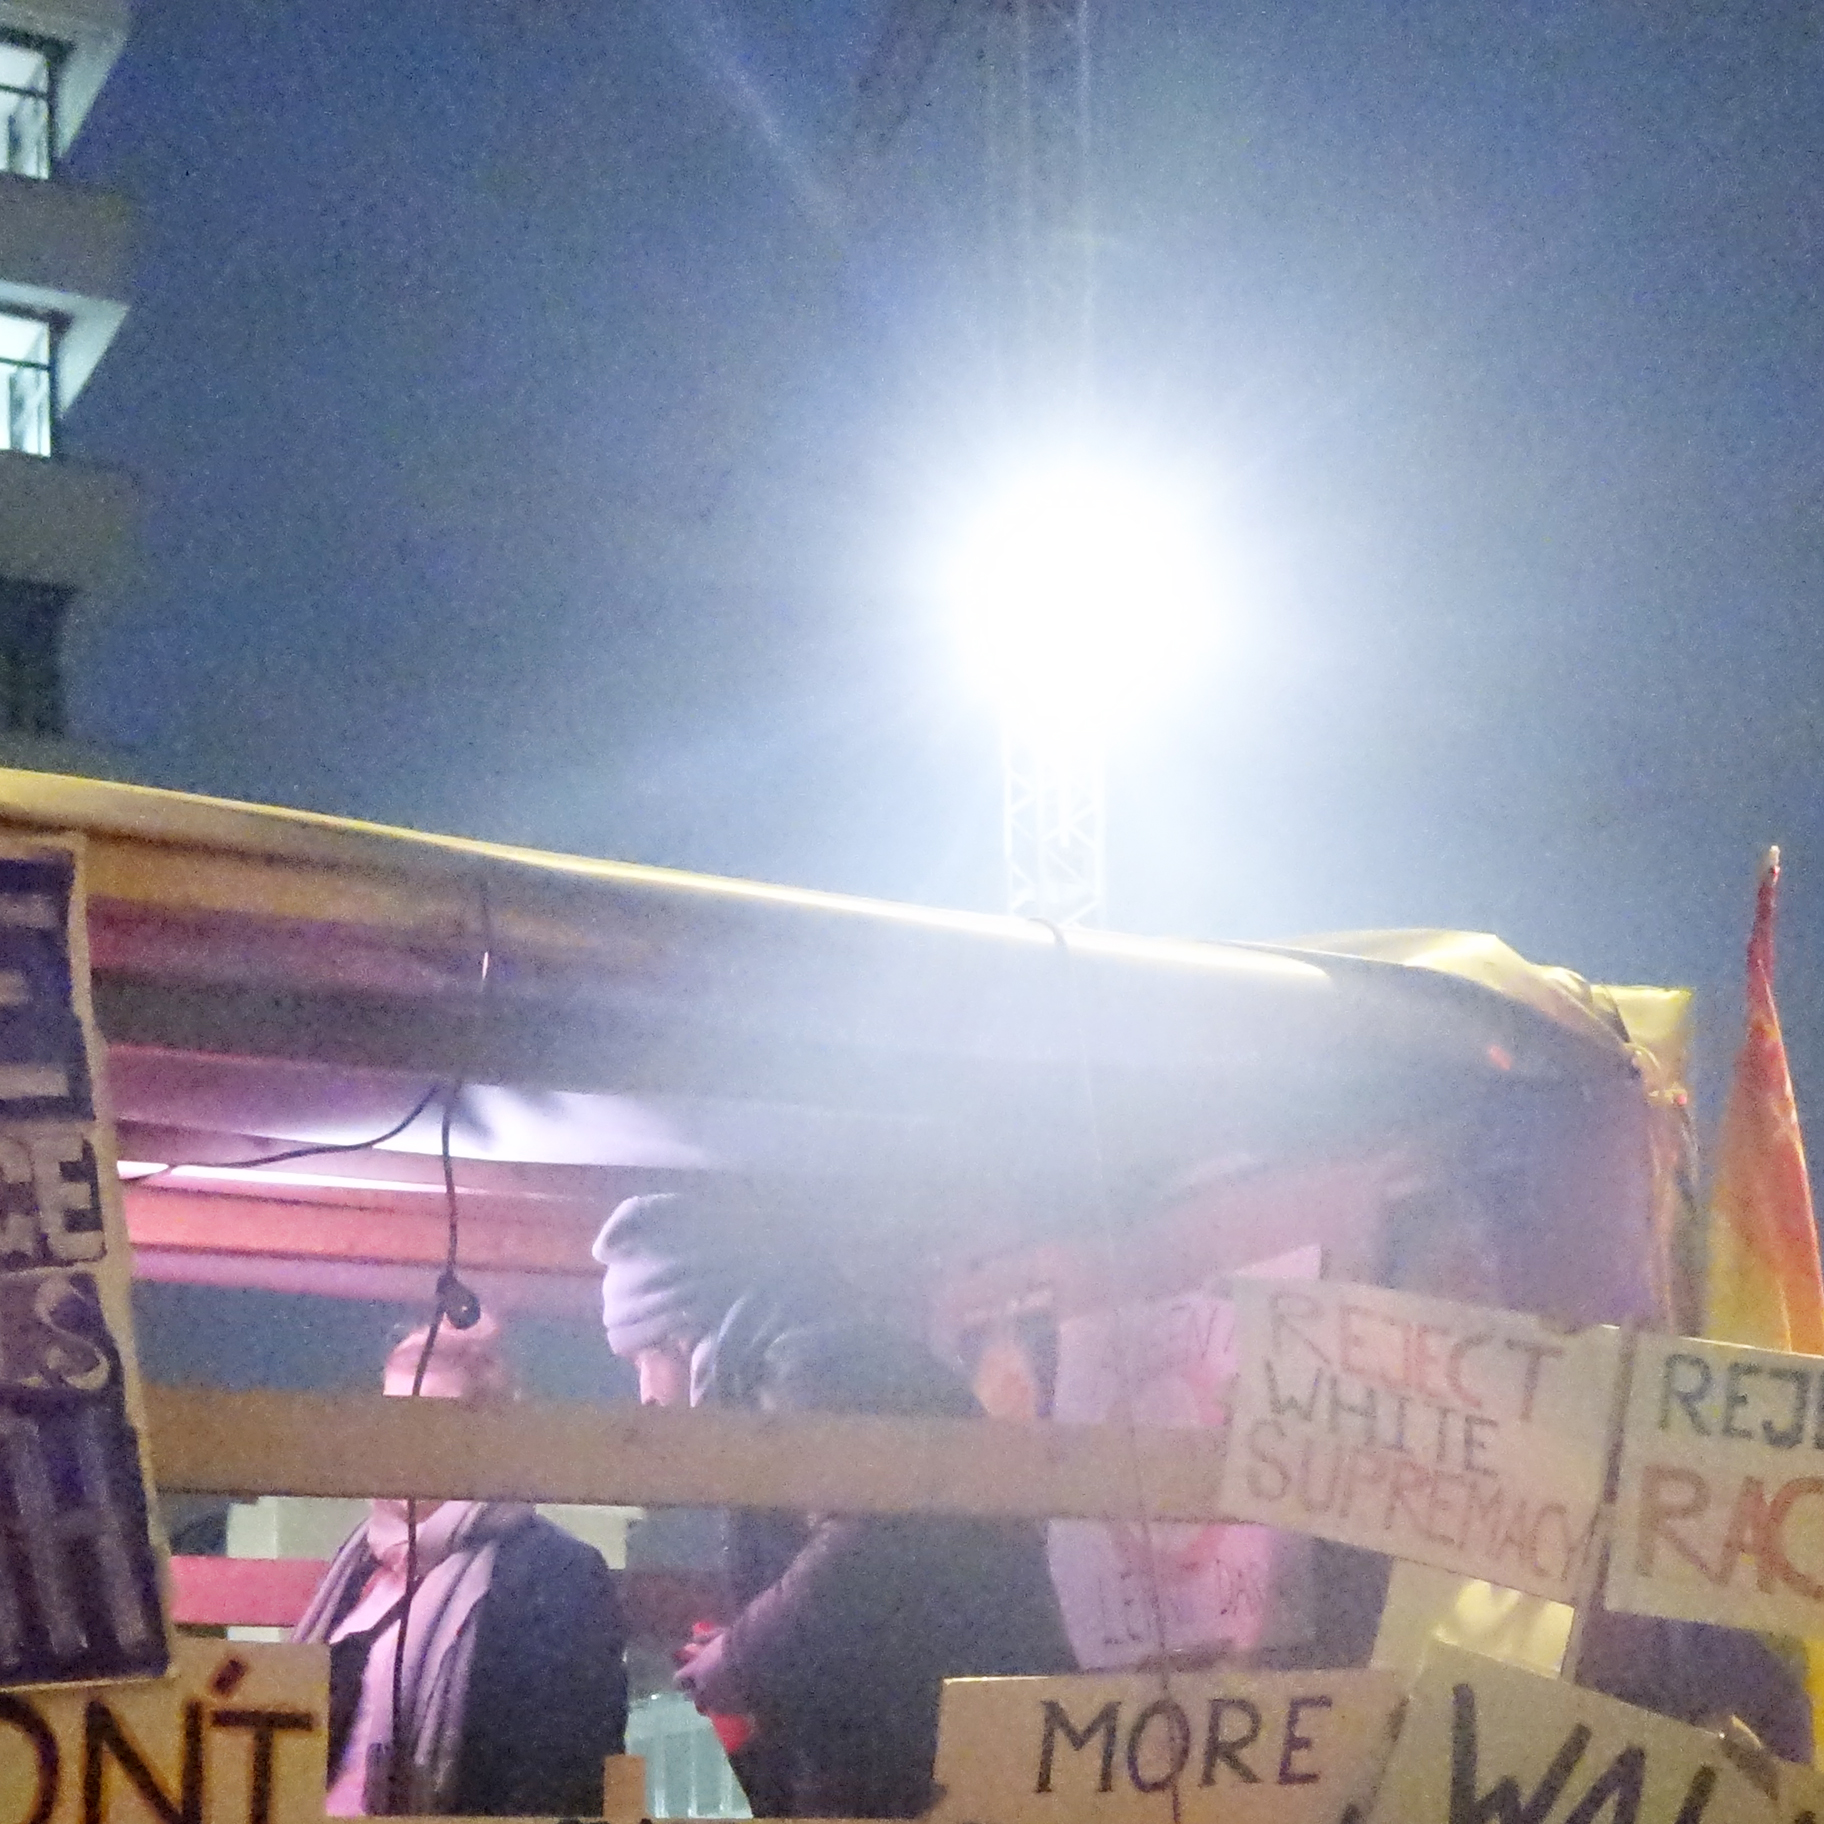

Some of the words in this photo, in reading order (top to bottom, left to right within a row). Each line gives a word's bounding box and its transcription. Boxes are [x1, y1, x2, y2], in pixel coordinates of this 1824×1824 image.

[1262, 1358, 1500, 1478] WHITE
[1269, 1290, 1564, 1425] REJECT
[1246, 1417, 1588, 1584] SUPREMACY
[1037, 1695, 1333, 1793] MORE
